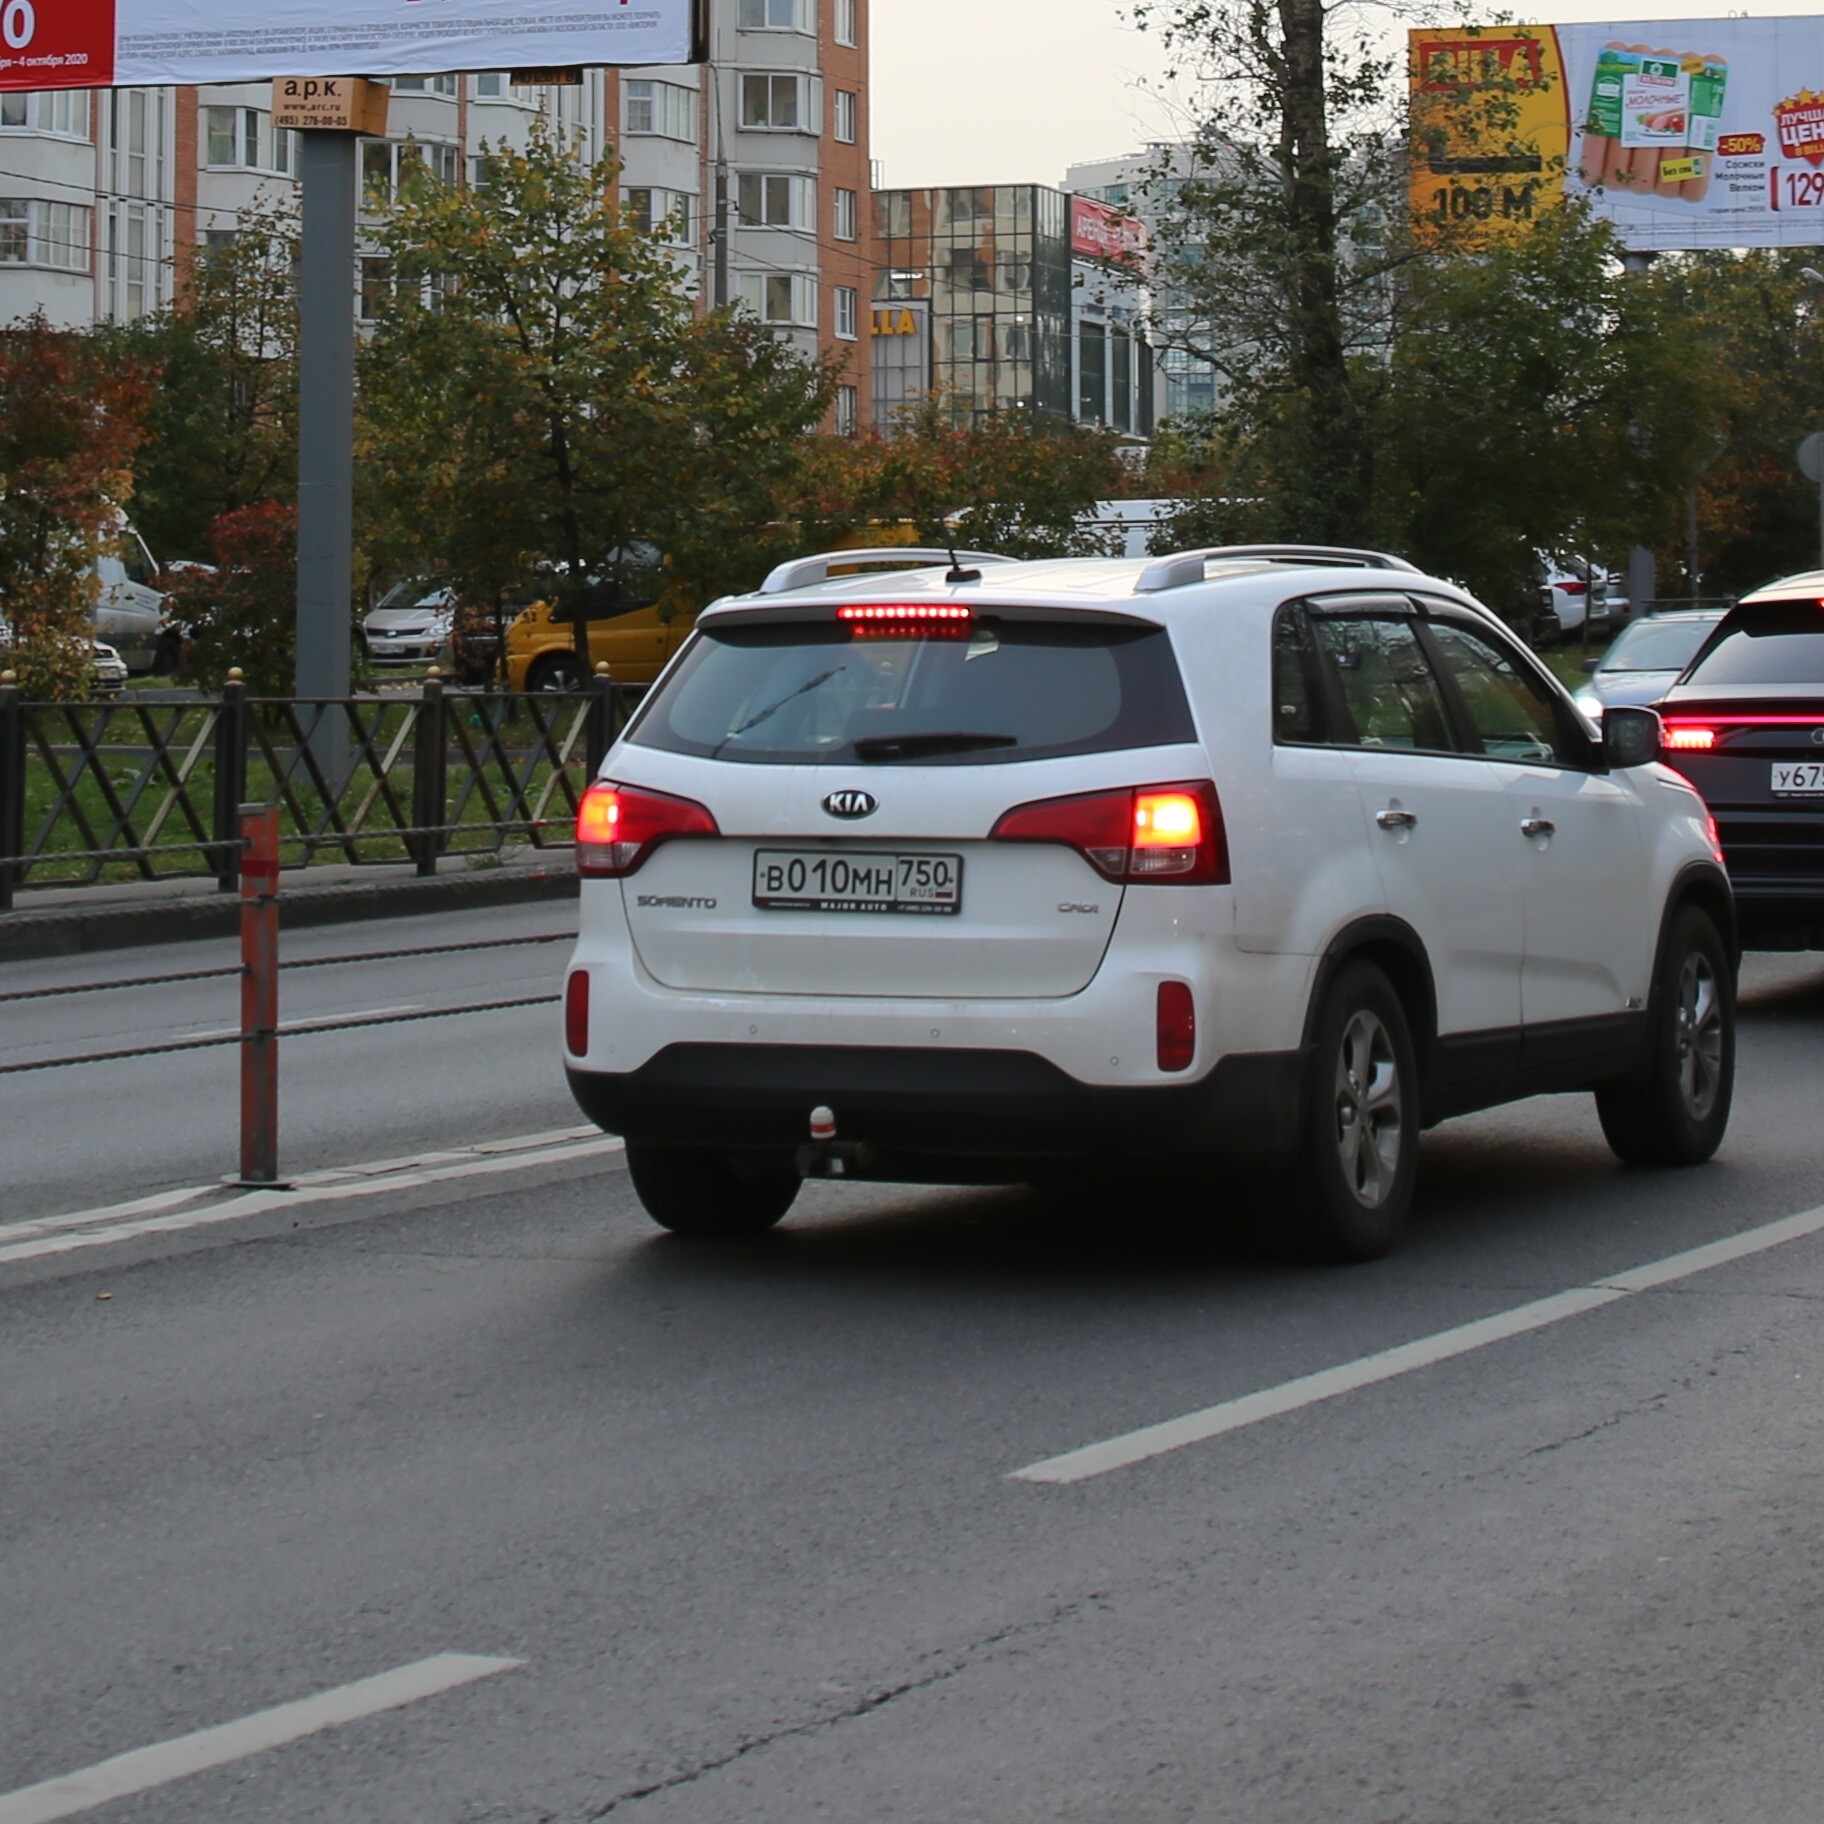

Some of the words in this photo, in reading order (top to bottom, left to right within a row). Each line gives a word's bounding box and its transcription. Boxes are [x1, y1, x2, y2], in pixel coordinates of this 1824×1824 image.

[18, 56, 26, 67] 4
[26, 53, 64, 68] октября
[64, 52, 89, 65] 2020
[1721, 137, 1762, 153] -50%
[1725, 160, 1766, 169] Сосиски
[1714, 172, 1766, 182] Молочные
[1729, 183, 1766, 192] Велком
[828, 792, 870, 812] KIA
[899, 859, 949, 887] 750
[910, 888, 935, 898] RUS
[637, 894, 718, 909] SORENTO
[819, 901, 857, 911] MAJOR
[860, 902, 888, 912] AUTO
